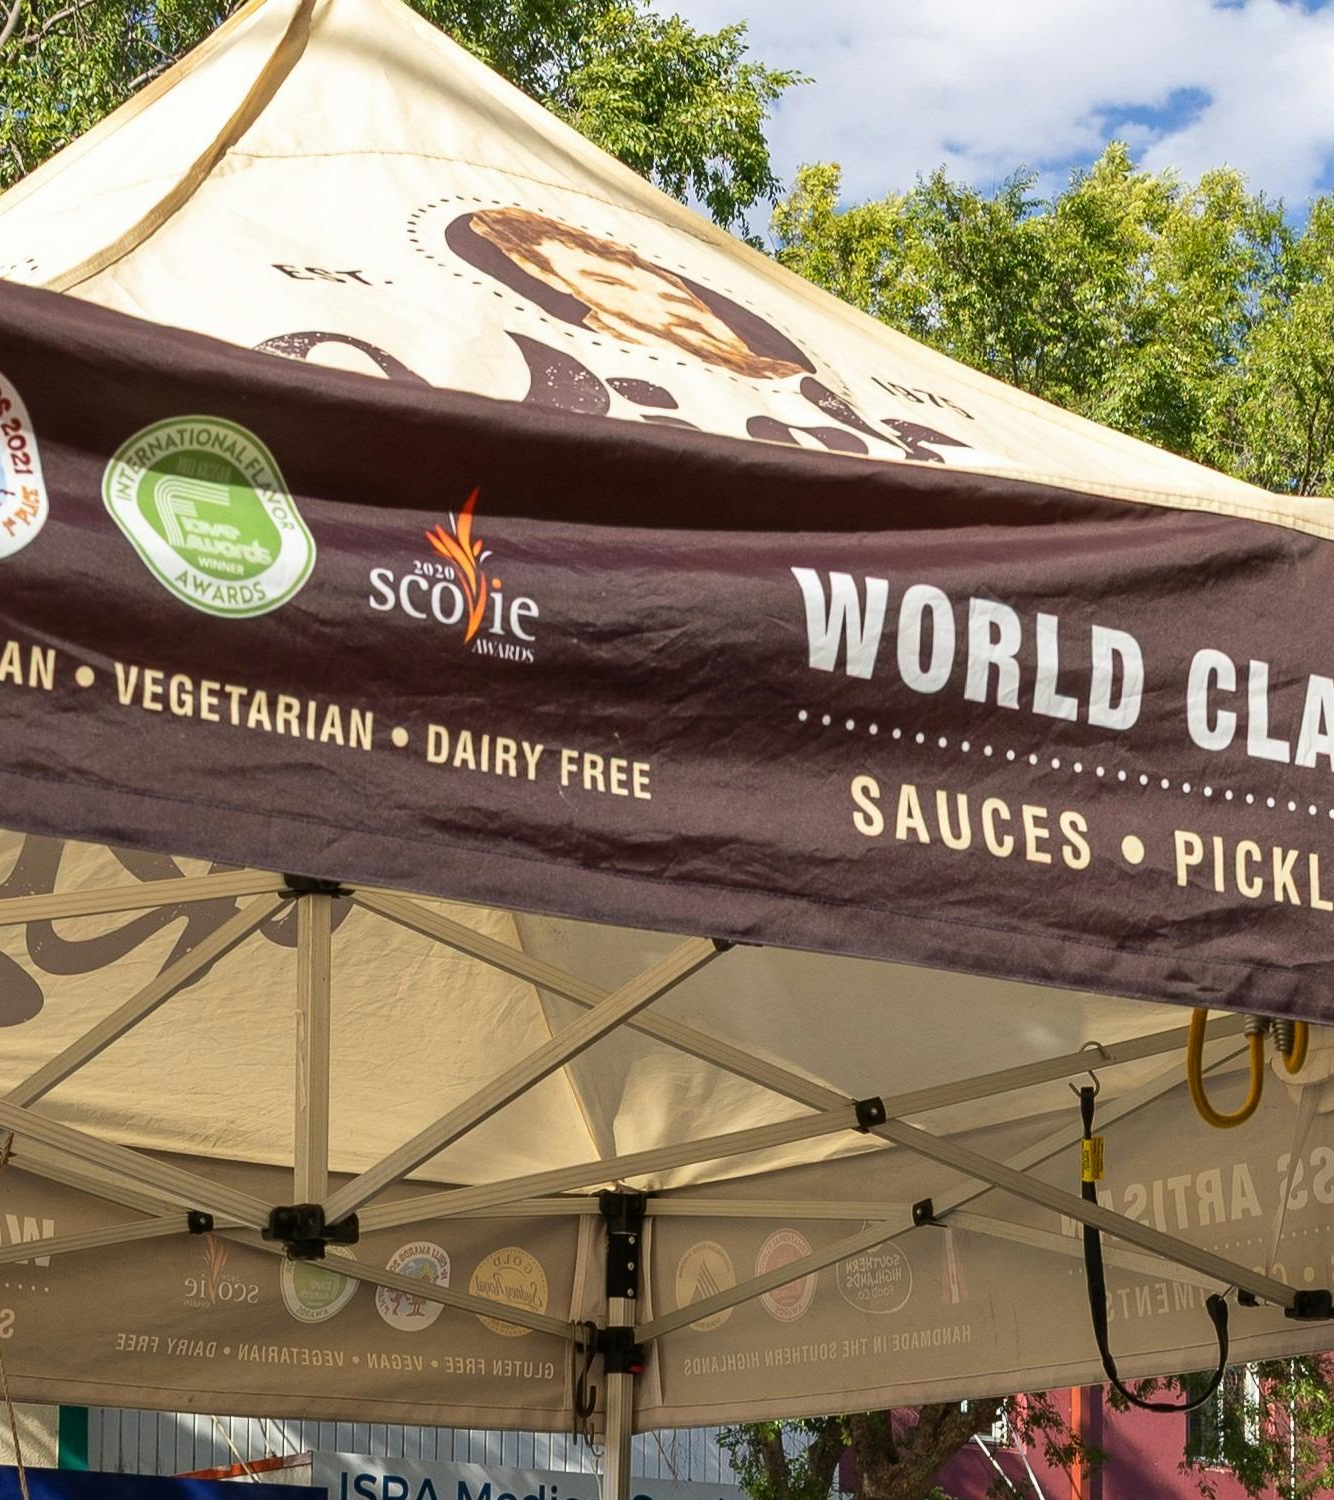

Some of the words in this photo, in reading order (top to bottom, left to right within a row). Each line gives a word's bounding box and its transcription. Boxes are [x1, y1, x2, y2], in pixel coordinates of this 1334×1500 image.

[271, 263, 394, 288] EST.
[0, 418, 33, 477] 2021
[116, 428, 244, 501] INTERNATIONAL
[244, 458, 296, 531] FLAVOR
[175, 569, 267, 606] AWARDS
[197, 555, 245, 576] WINNER
[413, 560, 456, 581] 2020
[471, 637, 535, 664] AWARDS
[791, 566, 1145, 732] WORLD
[114, 662, 373, 751] VEGETARIAN
[427, 723, 543, 781] DAIRY
[560, 750, 652, 799] FREE
[851, 774, 1093, 871] SAUCES
